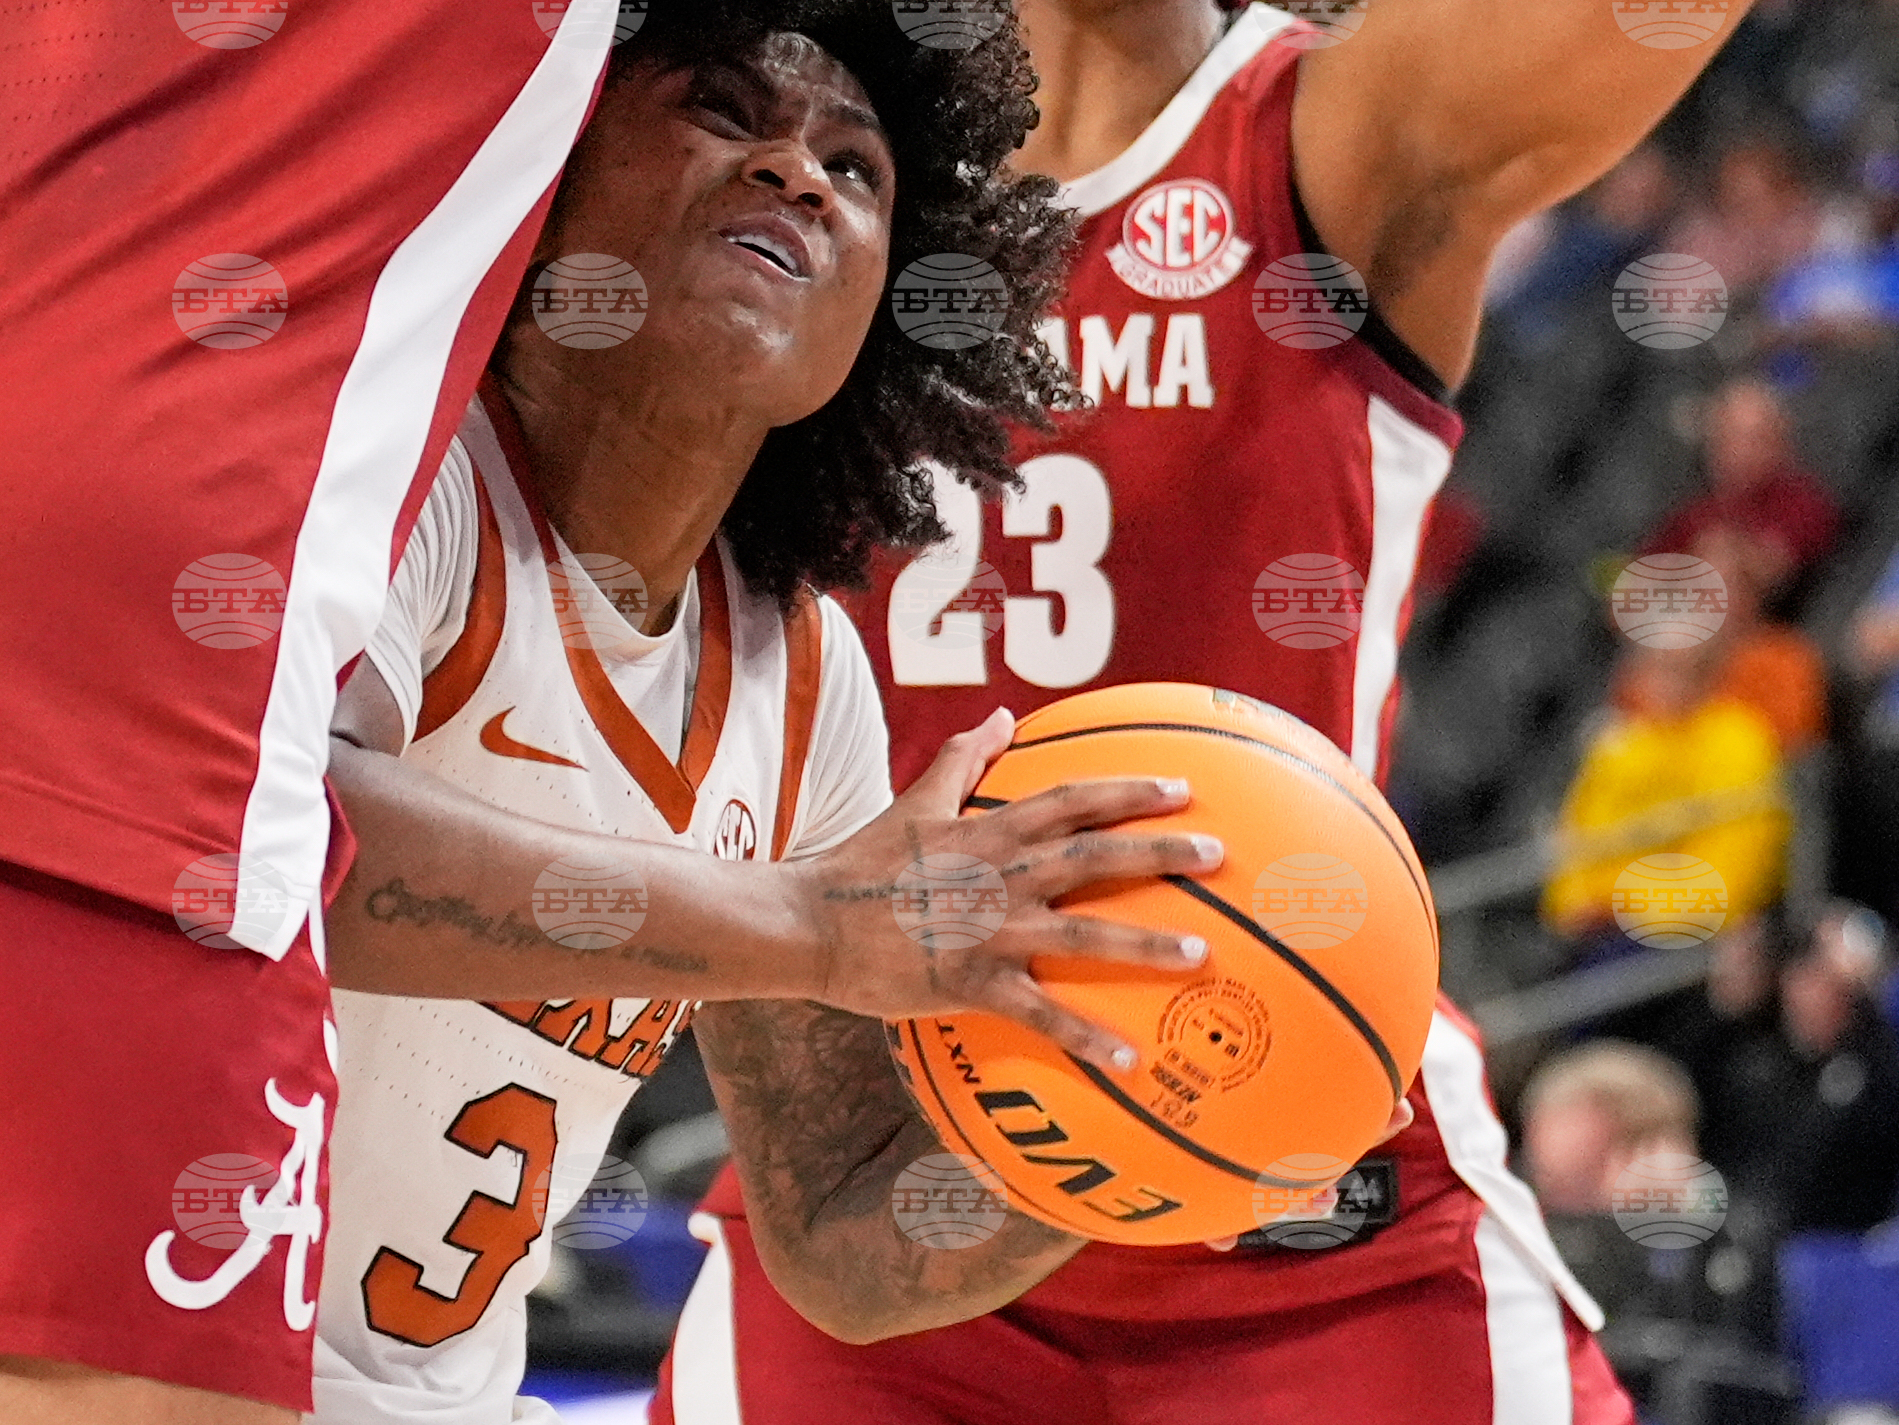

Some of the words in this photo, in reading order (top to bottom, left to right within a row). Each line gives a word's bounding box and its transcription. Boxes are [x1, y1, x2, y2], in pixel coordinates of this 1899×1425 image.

[1133, 187, 1222, 268] SEC
[887, 453, 1116, 689] 23
[934, 1017, 981, 1085] NXT
[360, 1081, 558, 1348] 3
[974, 1089, 1184, 1223] EVO
